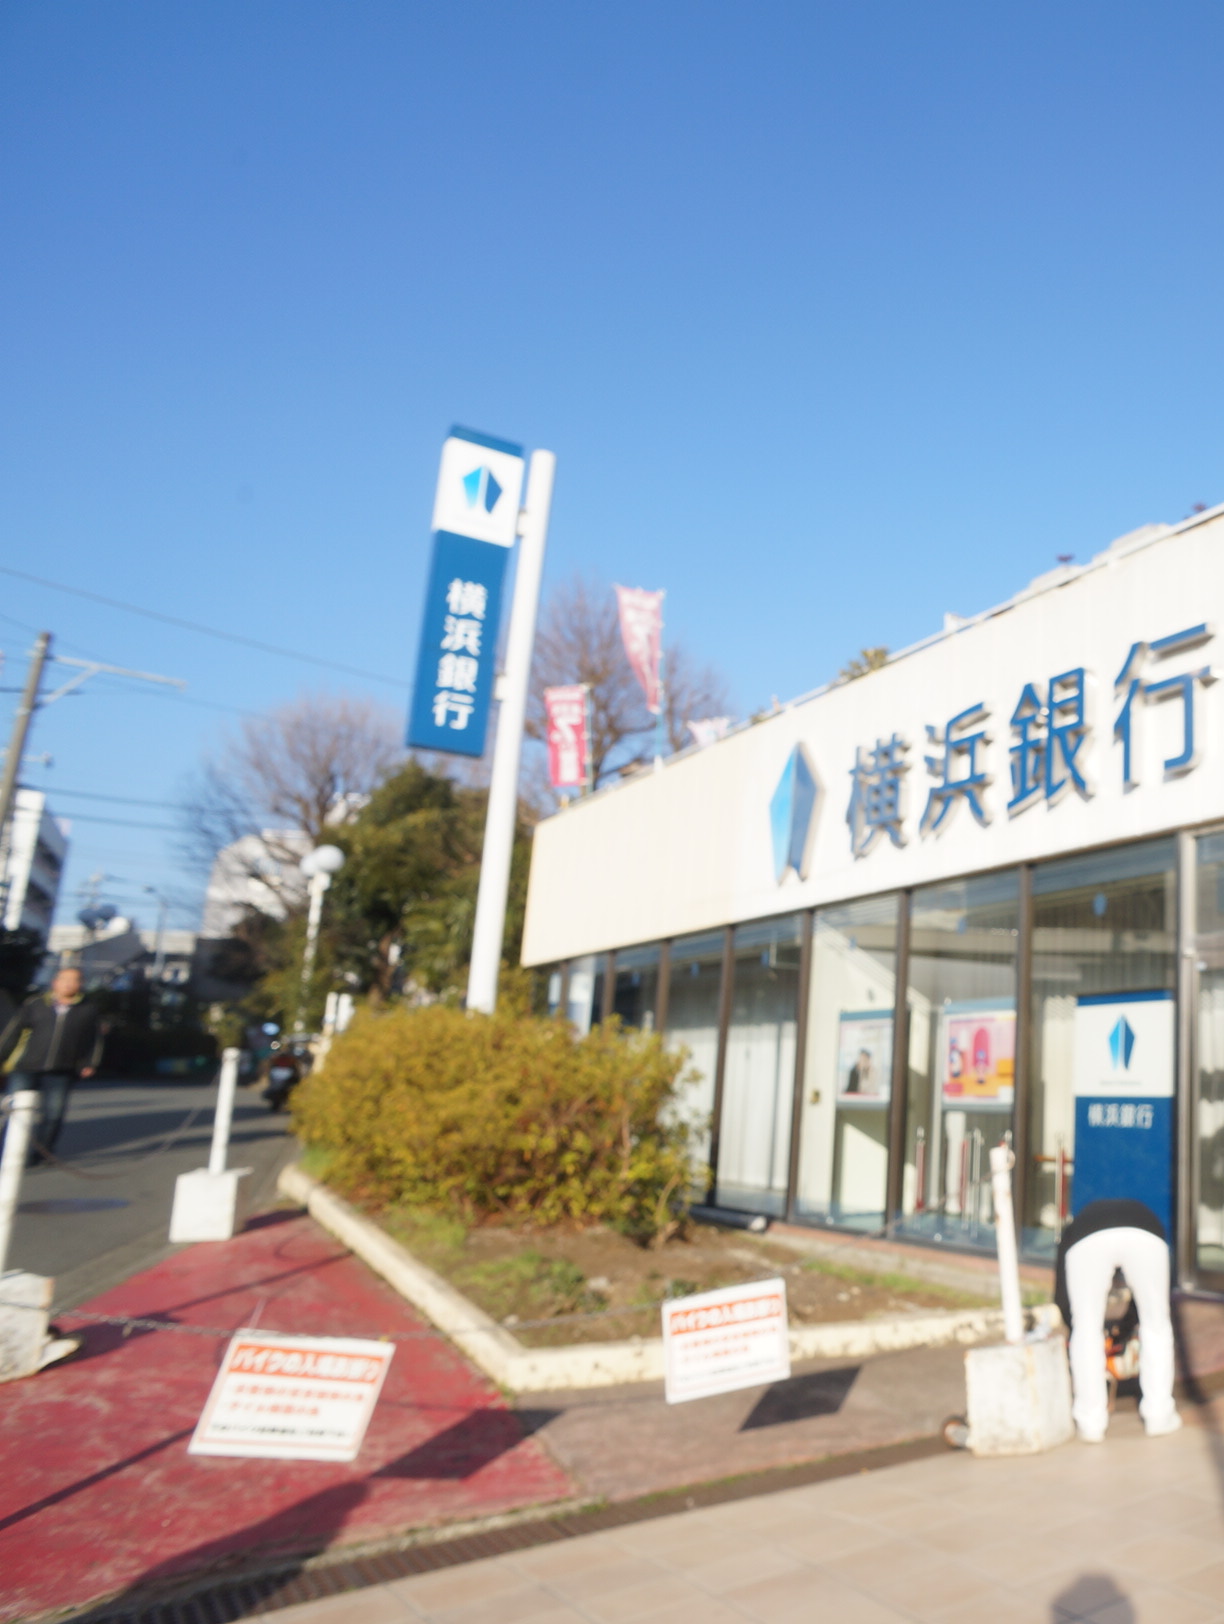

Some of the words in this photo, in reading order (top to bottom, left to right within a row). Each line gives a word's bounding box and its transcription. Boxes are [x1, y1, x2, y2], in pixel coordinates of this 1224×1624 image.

[432, 579, 488, 731] 横浜銀行
[846, 622, 1218, 859] 横浜銀行
[1088, 1102, 1154, 1129] 横浜銀行
